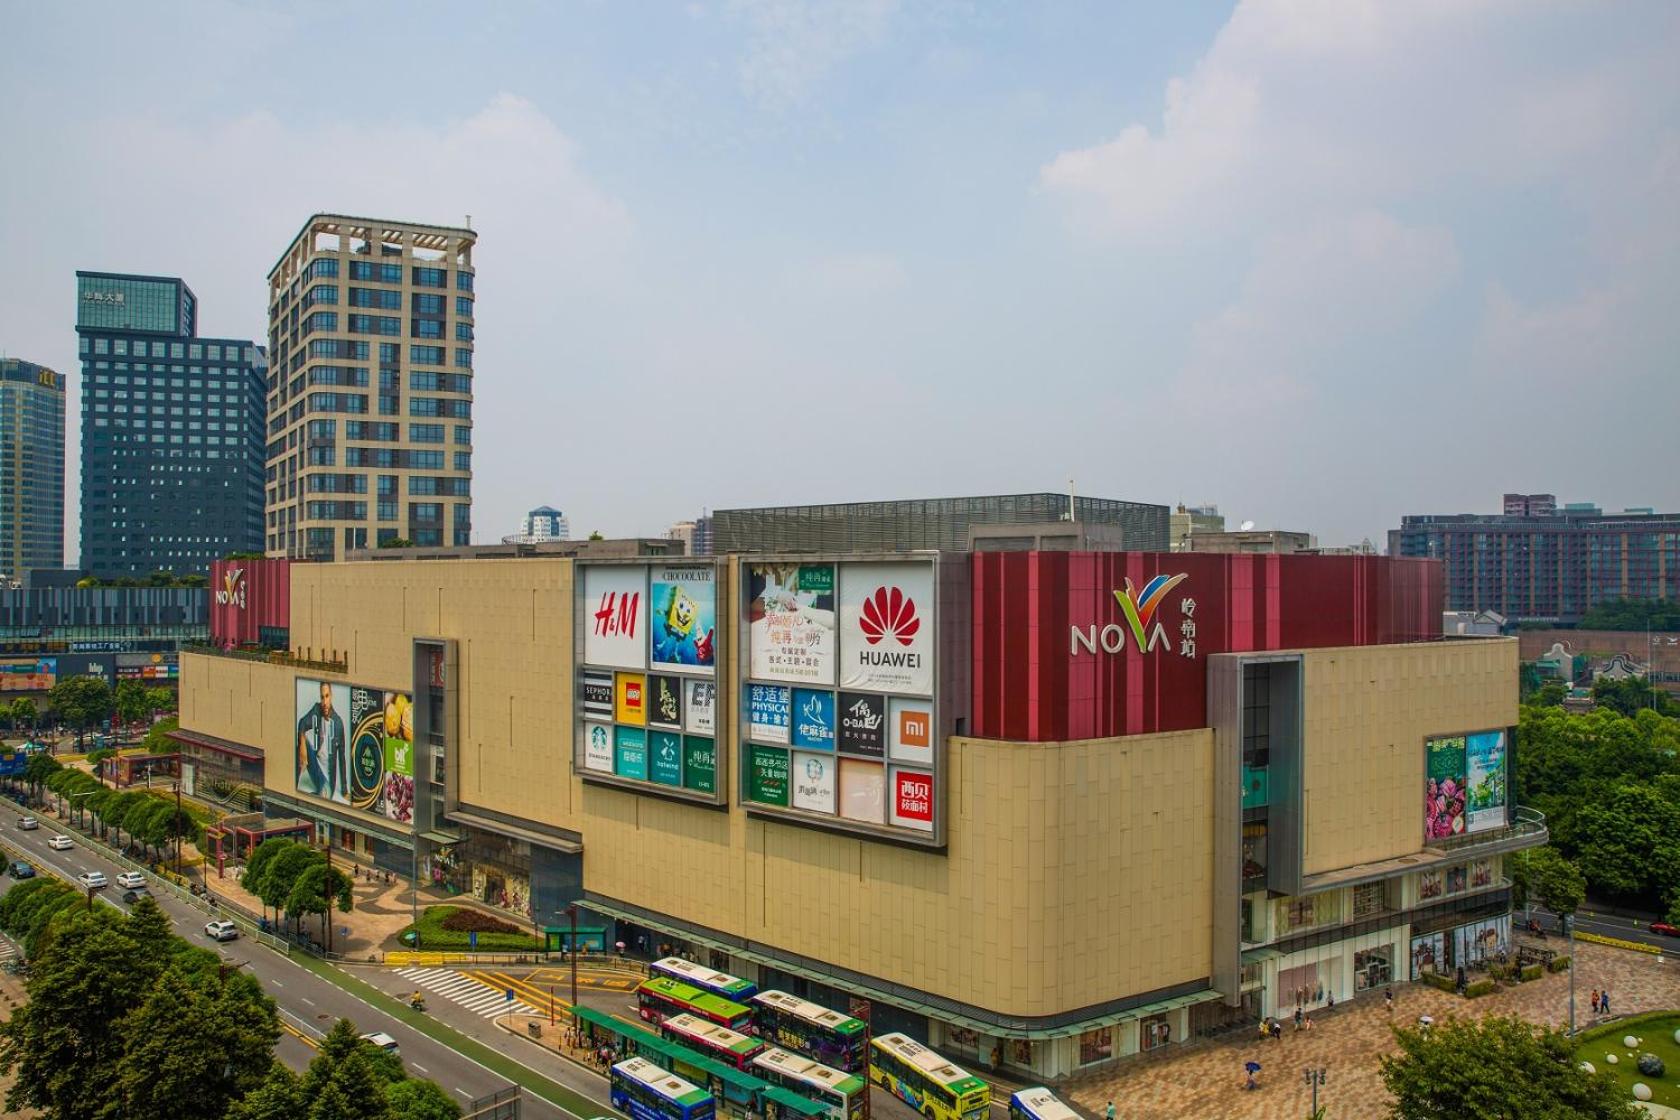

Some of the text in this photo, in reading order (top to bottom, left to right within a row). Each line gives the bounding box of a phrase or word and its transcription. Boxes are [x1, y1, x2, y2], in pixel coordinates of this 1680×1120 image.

[594, 591, 639, 639] H&M
[1071, 573, 1189, 656] NOVA
[859, 651, 921, 668] HUAWEI
[586, 686, 611, 697] SEPHOR
[901, 780, 929, 800] 西贝
